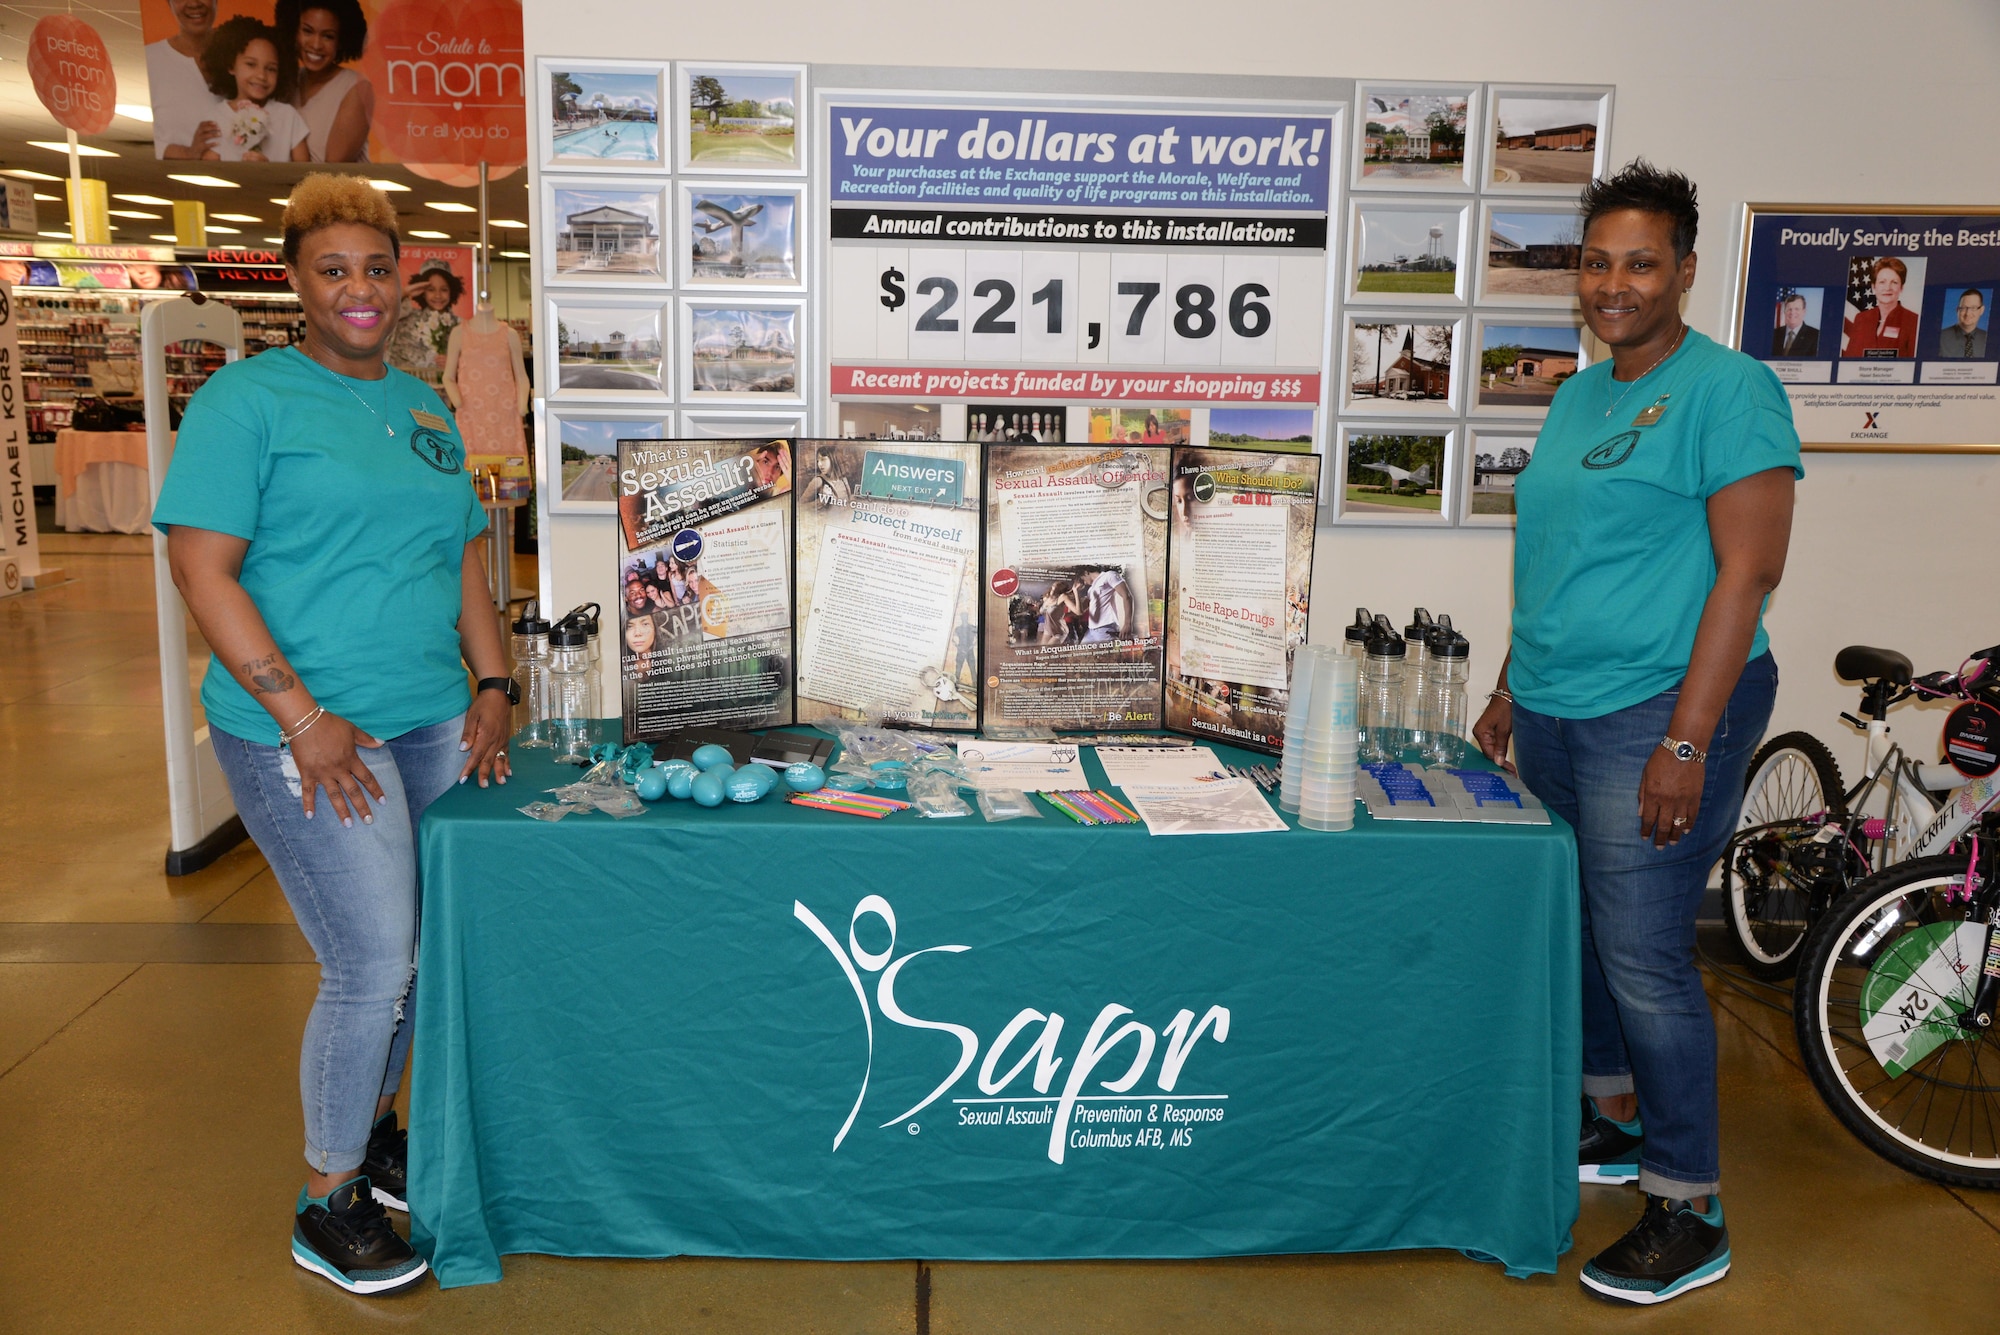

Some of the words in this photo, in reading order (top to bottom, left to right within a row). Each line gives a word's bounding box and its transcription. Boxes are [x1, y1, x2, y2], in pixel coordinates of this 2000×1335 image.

[47, 36, 100, 60] perfect
[417, 31, 474, 56] Salute
[478, 38, 492, 54] to
[59, 60, 106, 84] mom
[387, 60, 525, 97] mom
[51, 81, 101, 112] gifts
[406, 121, 428, 137] for
[433, 122, 449, 138] all
[452, 125, 484, 141] you
[487, 124, 510, 139] do
[839, 117, 949, 159] Your
[957, 117, 1118, 163] dollars
[1127, 126, 1181, 165] at
[1190, 125, 1326, 167] work!
[852, 164, 885, 178] Your
[886, 165, 958, 181] purchases
[960, 167, 977, 180] at
[979, 166, 1002, 180] the
[1005, 167, 1071, 186] Exchange
[1074, 170, 1129, 186] support
[1132, 171, 1155, 184] the
[1158, 172, 1213, 187] Morale,
[1217, 172, 1271, 189] Welfare
[1274, 173, 1302, 187] and
[840, 180, 917, 195] Recreation
[917, 181, 981, 198] facilities
[983, 184, 1010, 197] and
[1012, 184, 1064, 201] quality
[1066, 185, 1083, 201] of
[1084, 185, 1108, 203] life
[1110, 189, 1178, 204] programs
[1181, 191, 1198, 201] on
[1201, 188, 1228, 202] this
[1229, 189, 1315, 204] installation.
[862, 214, 943, 235] Annual
[945, 216, 1090, 238] contributions
[1094, 220, 1118, 240] to
[1122, 219, 1162, 240] this
[1165, 220, 1296, 242] installation:
[1780, 228, 1851, 251] Proudly
[1852, 229, 1921, 252] Serving
[1923, 228, 1954, 247] the
[1957, 229, 2000, 247] Best!
[207, 249, 278, 263] REVLON
[0, 347, 15, 421] KORS
[850, 370, 923, 388] Recent
[925, 371, 1010, 395] projects
[1011, 372, 1087, 396] funded
[1090, 374, 1118, 395] by
[1119, 378, 1171, 398] your
[1173, 375, 1267, 399] shopping
[1269, 378, 1302, 399] $$$
[1795, 393, 1818, 401] provide
[1873, 393, 1896, 401] service,
[1896, 393, 1917, 402] quality
[1978, 393, 1996, 401] value.
[632, 449, 672, 466] What
[676, 446, 689, 459] is
[1005, 470, 1025, 479] How
[1025, 468, 1040, 476] can
[1040, 466, 1046, 474] I
[1046, 459, 1084, 475] reduce
[1085, 454, 1102, 466] the
[1103, 449, 1125, 461] risk
[620, 450, 717, 497] Sexual
[872, 459, 955, 484] Answers
[995, 476, 1043, 491] Sexual
[1046, 473, 1100, 488] Assault
[1101, 470, 1167, 484] Offender
[1216, 472, 1240, 484] What
[1240, 473, 1275, 487] Should
[1275, 478, 1280, 488] I
[1283, 477, 1303, 490] Do?
[5, 429, 28, 546] MICHAEL
[643, 455, 755, 522] Assault?
[892, 484, 912, 493] NEXT
[914, 486, 933, 495] EXIT
[1232, 491, 1254, 506] call
[1255, 493, 1273, 507] 911
[1280, 497, 1292, 506] the
[1292, 497, 1315, 506] police.
[817, 493, 848, 507] What
[850, 502, 870, 511] can
[872, 503, 878, 511] I
[879, 506, 896, 515] do
[897, 507, 910, 517] to
[851, 510, 907, 531] protect
[910, 521, 963, 543] myself
[713, 540, 749, 549] Statistics
[892, 530, 912, 541] from
[913, 535, 940, 549] sexual
[941, 543, 975, 556] assault?
[1188, 597, 1212, 613] Date
[1213, 602, 1240, 620] Rape
[1240, 608, 1276, 629] Drugs
[623, 663, 640, 672] use
[640, 661, 650, 670] of
[676, 651, 711, 668] physical
[712, 647, 736, 658] threat
[737, 646, 747, 654] or
[748, 642, 771, 653] abuse
[772, 637, 780, 647] of
[641, 647, 675, 660] assault
[676, 646, 684, 654] is
[685, 640, 729, 654] intentional
[729, 635, 756, 646] sexual
[1015, 649, 1033, 658] What
[1033, 648, 1040, 656] is
[1040, 642, 1098, 655] Acquaintance
[1099, 640, 1114, 649] and
[1114, 638, 1133, 648] Date
[1133, 637, 1158, 648] Rape?
[630, 671, 644, 681] the
[646, 667, 674, 678] victim
[675, 663, 696, 673] does
[697, 658, 711, 669] not
[712, 658, 722, 667] or
[723, 653, 751, 665] cannot
[1107, 712, 1123, 722] Be
[1124, 711, 1156, 722] Alert.
[1191, 717, 1220, 733] Sexual
[1220, 725, 1252, 741] Assault
[1252, 733, 1261, 742] is
[1260, 736, 1267, 744] a
[877, 944, 1231, 1165] Sapr
[958, 1105, 1004, 1126] Sexual
[1005, 1105, 1054, 1125] Assault
[1074, 1103, 1143, 1124] Prevention
[1147, 1103, 1159, 1123] &
[1162, 1102, 1225, 1126] Response
[1070, 1127, 1133, 1149] Columbus
[1134, 1128, 1166, 1150] AFB,
[1169, 1127, 1194, 1148] MS
